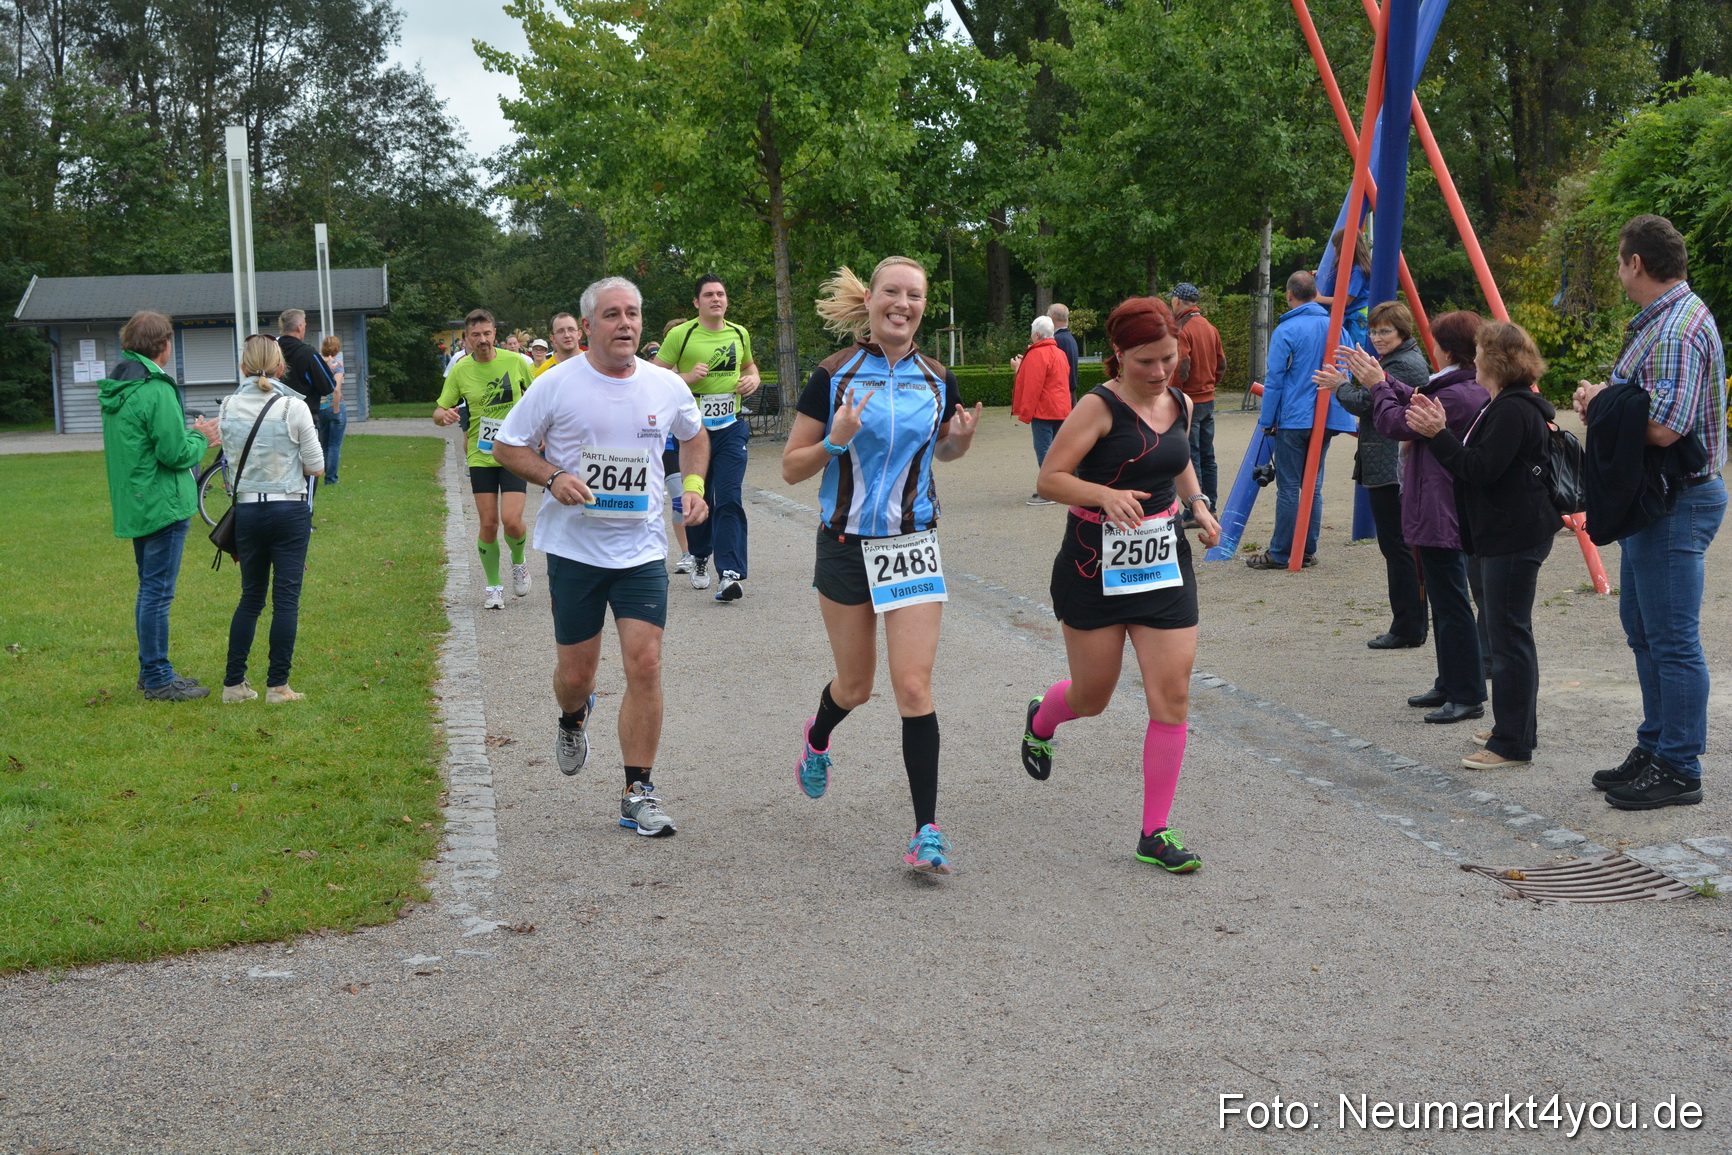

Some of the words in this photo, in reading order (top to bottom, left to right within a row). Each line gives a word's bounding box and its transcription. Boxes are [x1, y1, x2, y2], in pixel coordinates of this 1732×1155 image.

[704, 400, 735, 417] 2330
[582, 451, 607, 462] PARTL
[608, 455, 645, 464] Neumarkt
[586, 463, 647, 492] 2644
[594, 497, 635, 510] Andreas
[1133, 525, 1166, 536] Neumarkt
[864, 545, 891, 554] PARTL
[892, 537, 929, 550] Neumarkt
[1111, 535, 1170, 566] 2505
[873, 546, 938, 583] 2483
[1120, 570, 1162, 584] Susanne
[890, 582, 935, 599] Vanessa
